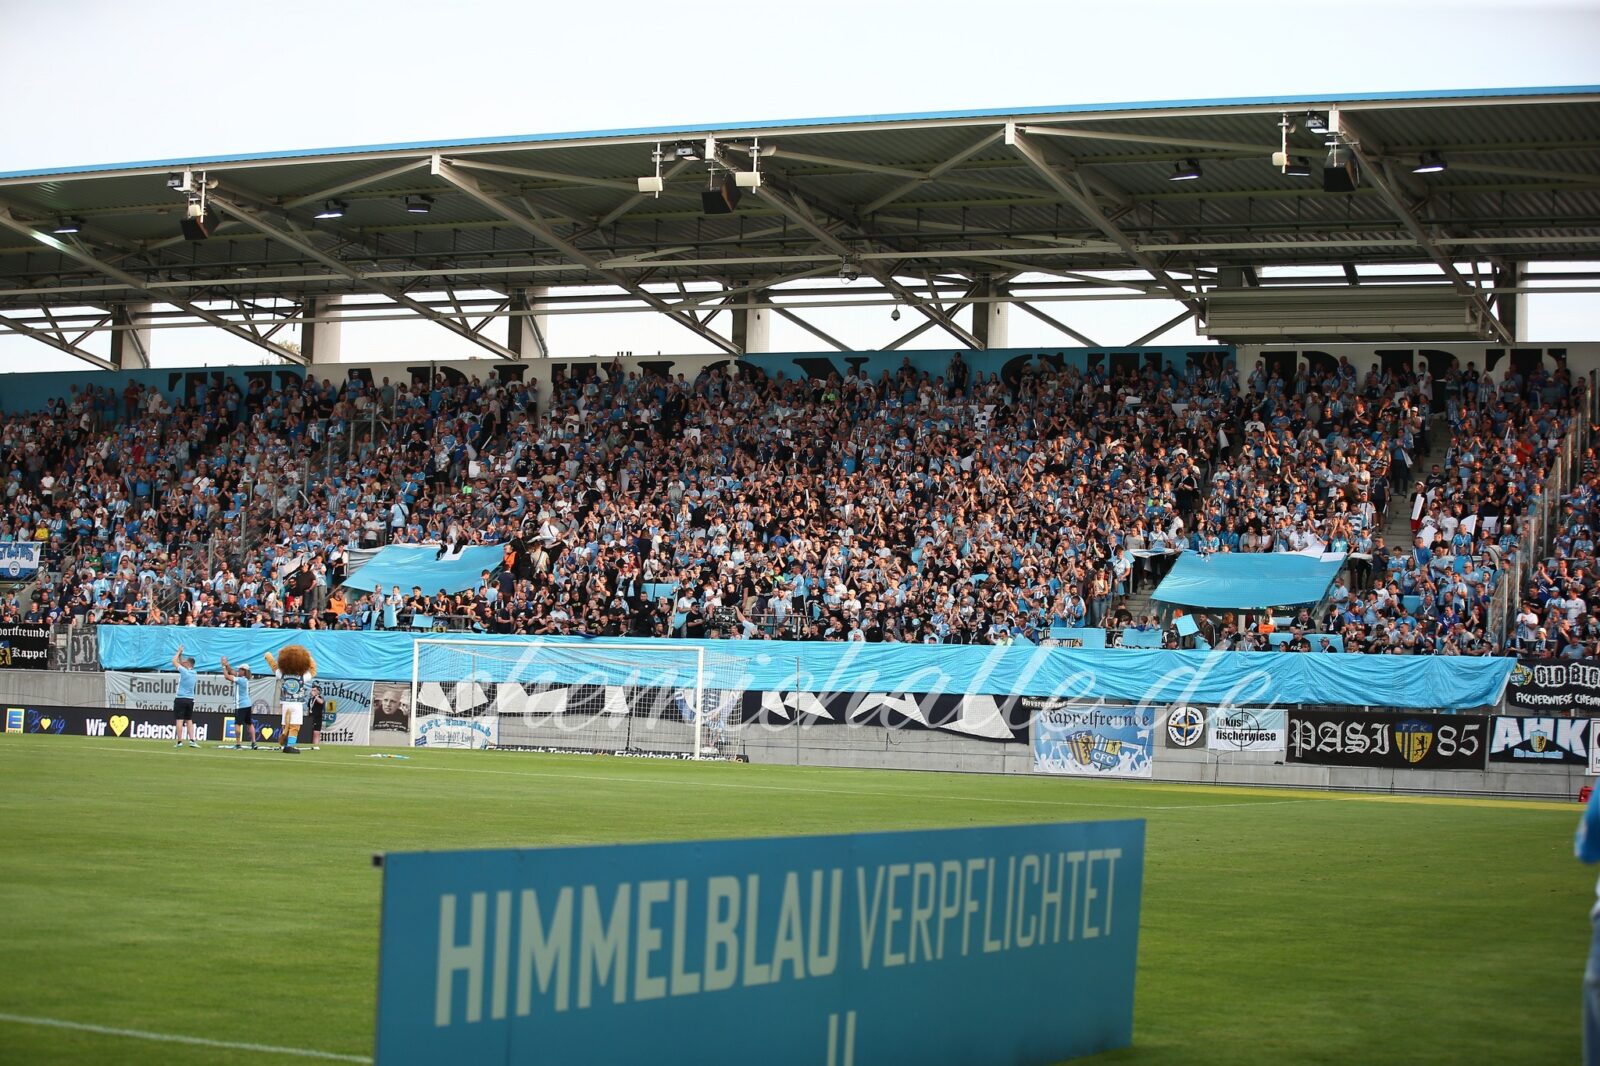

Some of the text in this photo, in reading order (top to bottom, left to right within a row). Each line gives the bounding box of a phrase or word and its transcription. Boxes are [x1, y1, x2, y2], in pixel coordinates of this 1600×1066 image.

[11, 647, 48, 659] Kappel
[1534, 664, 1566, 687] OLD
[86, 718, 107, 736] Wir
[1216, 717, 1242, 727] fokus
[1216, 730, 1276, 742] fischerwiese
[1437, 724, 1480, 757] 85
[1490, 717, 1590, 757] AHK
[1093, 752, 1114, 764] CFC
[435, 848, 1122, 1028] HIMMELBLAU VERPFLICHTET
